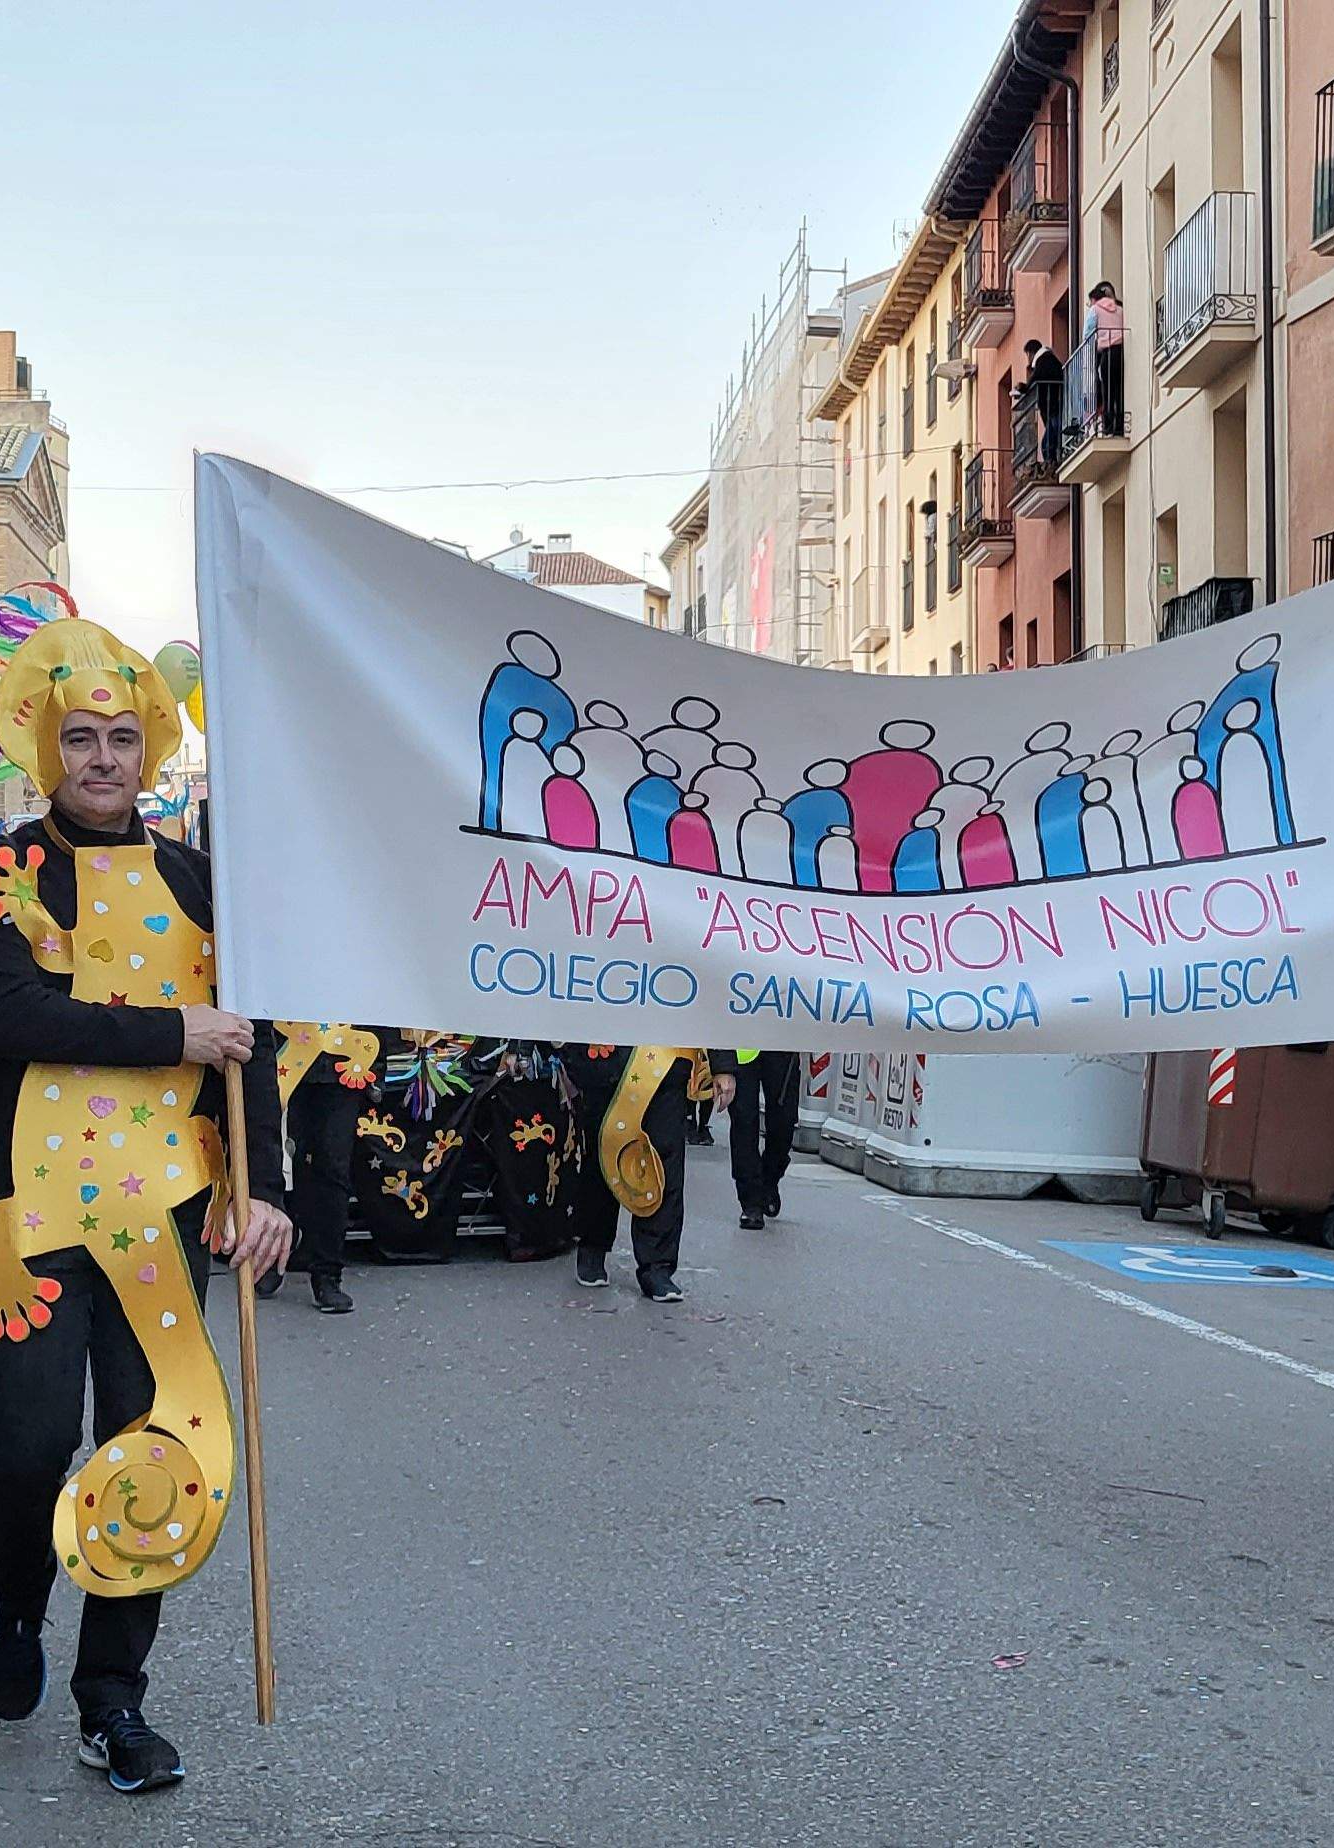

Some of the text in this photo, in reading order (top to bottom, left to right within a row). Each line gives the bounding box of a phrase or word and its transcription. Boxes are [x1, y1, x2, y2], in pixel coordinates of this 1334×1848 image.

[472, 857, 1305, 975] AMPA "ASCENSIÓN NICOL"
[470, 943, 699, 1008] COLEGIO
[729, 972, 875, 1028] SANTA
[905, 981, 1041, 1033] ROSA
[1118, 954, 1299, 1019] HUESCA
[883, 1107, 904, 1130] RESTO
